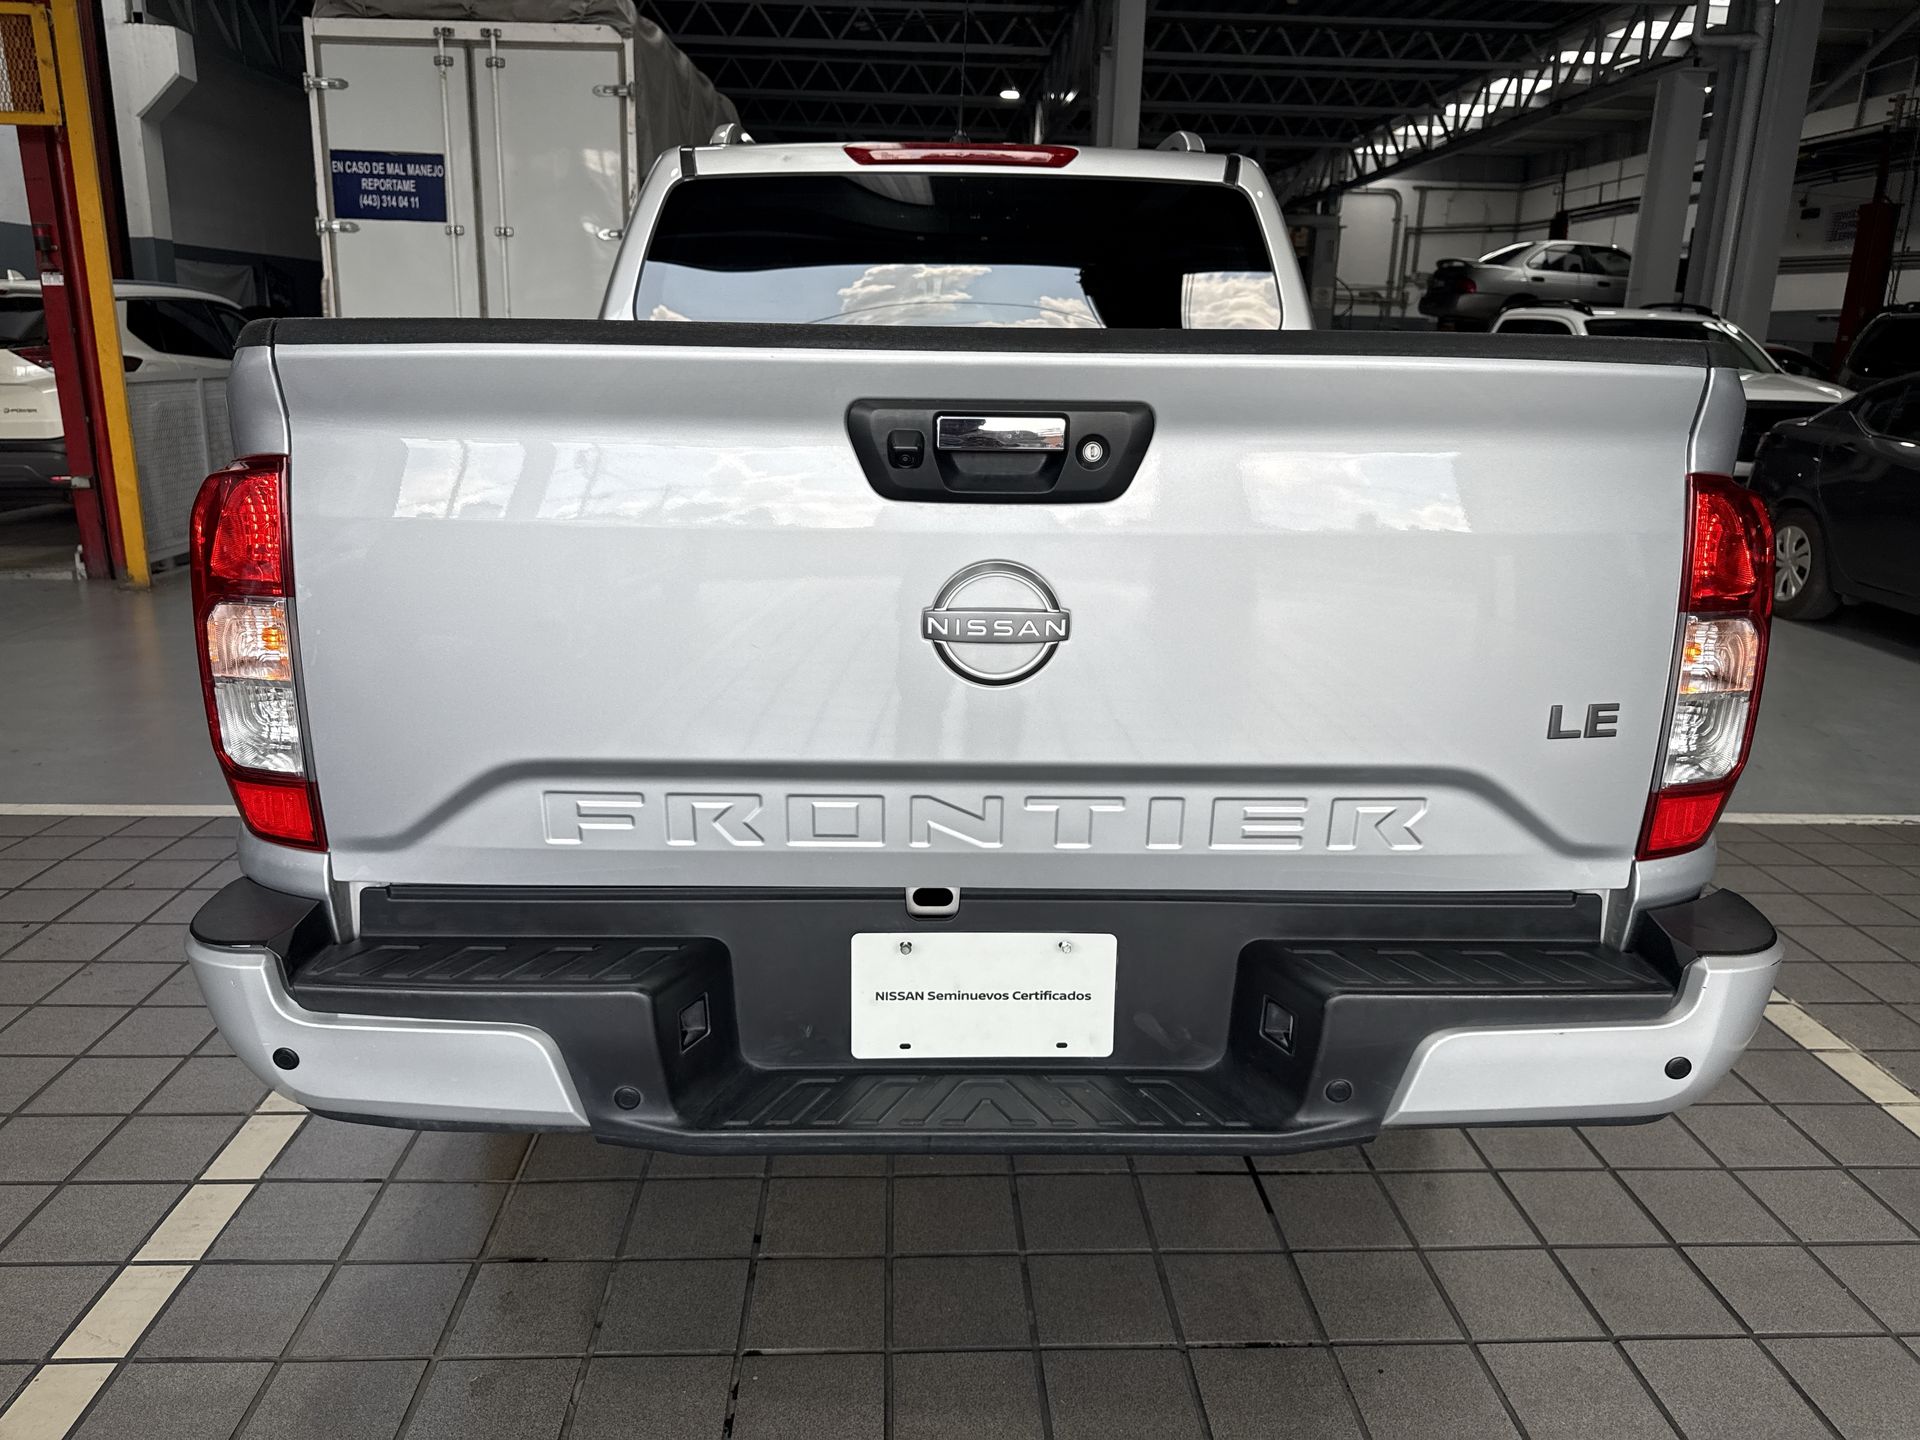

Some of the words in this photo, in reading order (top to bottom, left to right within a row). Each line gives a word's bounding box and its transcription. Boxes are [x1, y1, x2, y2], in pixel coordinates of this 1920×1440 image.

[332, 161, 343, 173] EN
[345, 161, 371, 174] CASO
[373, 162, 386, 174] DE
[386, 163, 405, 176] MAL
[407, 164, 444, 177] MANEJO
[361, 178, 416, 192] REPORTAME
[359, 194, 380, 210] (443)
[381, 195, 397, 208] 314
[398, 196, 409, 208] 04
[410, 197, 420, 208] 11
[927, 617, 1066, 637] NISSAN
[1547, 703, 1620, 739] LE
[542, 790, 1428, 850] FRONTIER
[875, 991, 924, 1001] NISSAN
[927, 990, 1009, 1001] Seminuevos
[1012, 990, 1092, 1001] Certificados
